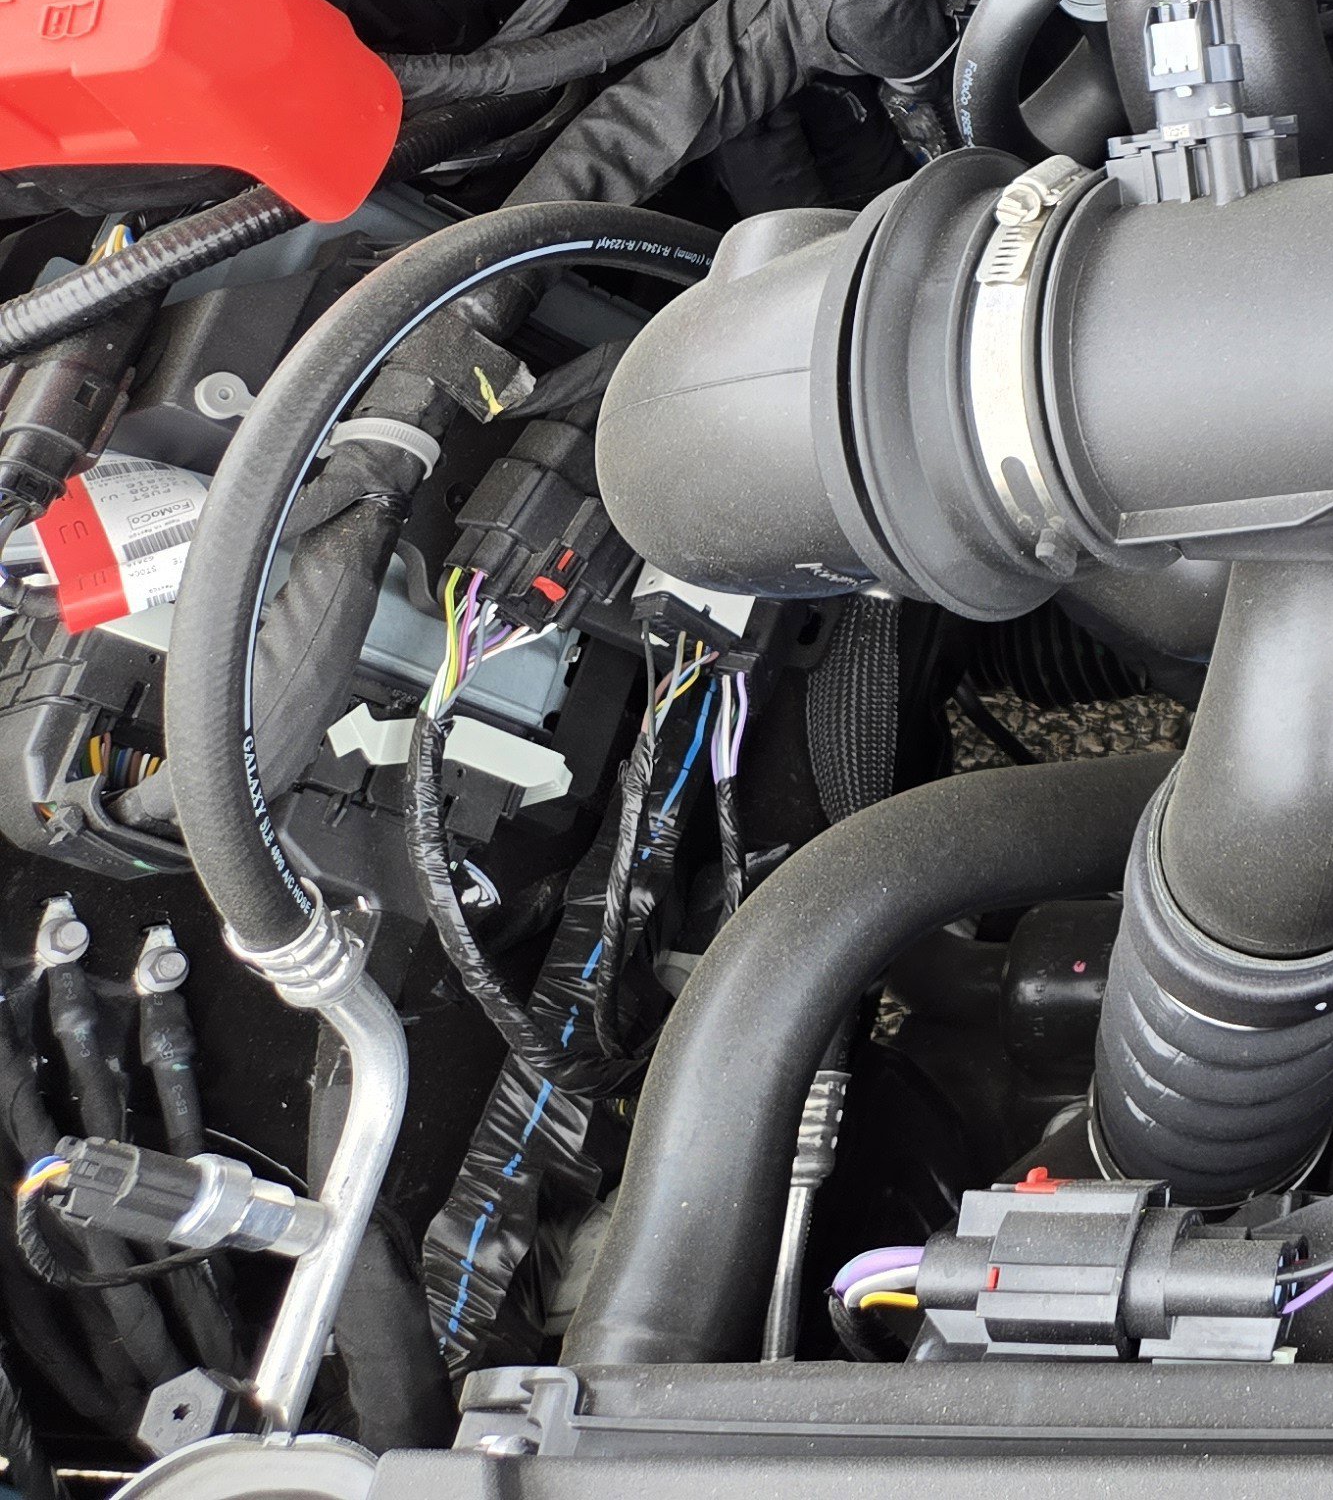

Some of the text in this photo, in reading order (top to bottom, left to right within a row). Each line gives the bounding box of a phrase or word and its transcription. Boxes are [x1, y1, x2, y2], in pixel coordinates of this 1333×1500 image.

[129, 499, 192, 526] FoMoCo
[57, 519, 90, 545] UJ
[242, 734, 267, 819] GALAXY
[259, 815, 276, 848] SLE
[281, 868, 295, 890] A/C
[292, 885, 312, 915] HOSE
